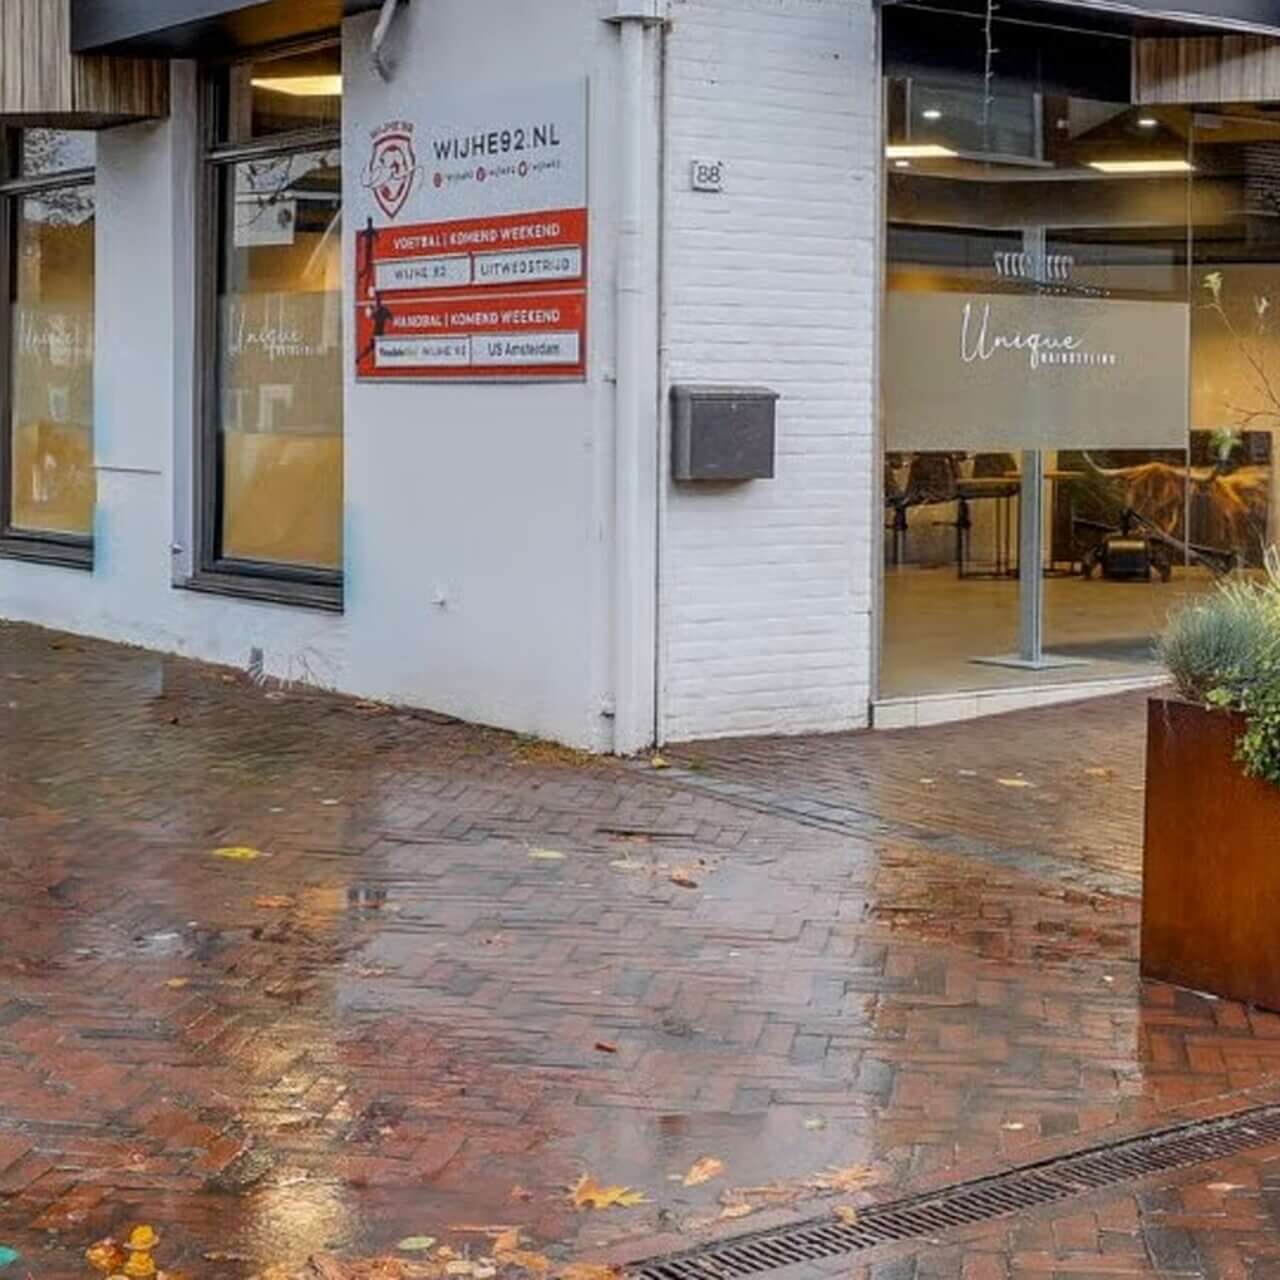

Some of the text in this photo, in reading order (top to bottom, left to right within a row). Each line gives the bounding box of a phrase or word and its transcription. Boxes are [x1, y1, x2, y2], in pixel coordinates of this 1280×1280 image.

[433, 123, 561, 160] WIJHE92.NL
[696, 165, 721, 184] 88
[393, 234, 443, 250] VOETBAL
[449, 228, 499, 246] KOMEND
[500, 223, 561, 240] WEEKEND
[393, 314, 443, 328] HANDBAL
[451, 311, 498, 327] KOMEND
[500, 308, 561, 324] WEEKEND
[486, 341, 561, 356] US Amsterdam
[961, 303, 1084, 371] Unique
